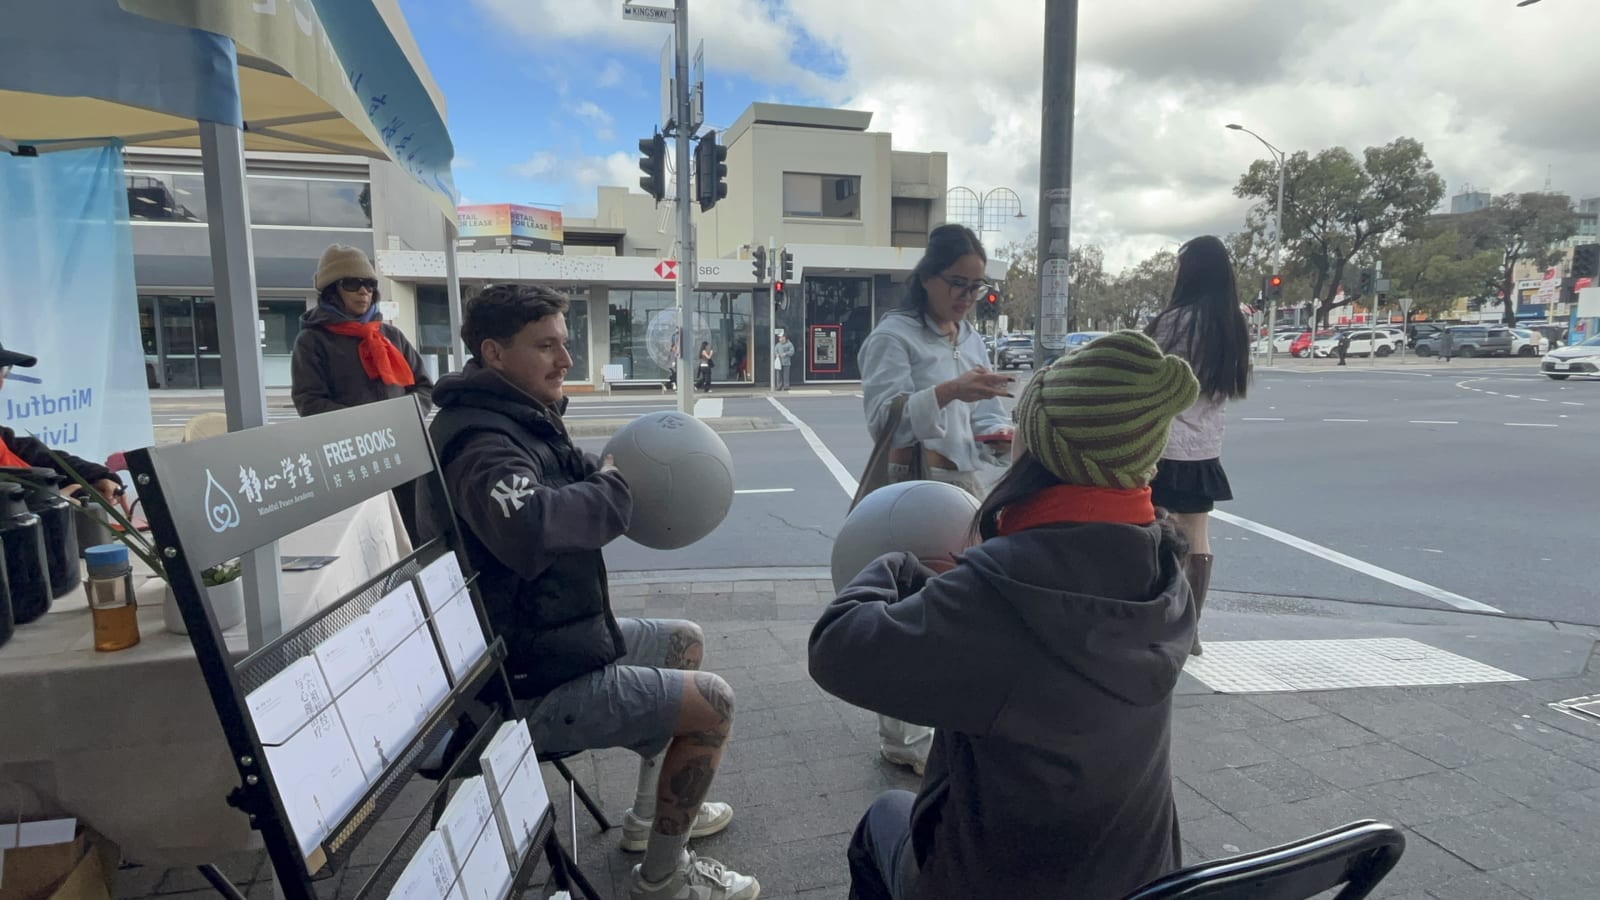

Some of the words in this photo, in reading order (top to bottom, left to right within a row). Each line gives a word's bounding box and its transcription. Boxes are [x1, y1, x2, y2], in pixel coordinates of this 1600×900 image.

[632, 8, 667, 18] KINGSWAY
[511, 213, 535, 222] RETAIL
[525, 221, 548, 230] LEASE
[323, 438, 357, 468] FREE
[355, 427, 396, 457] BOOKS
[490, 473, 535, 518] NY
